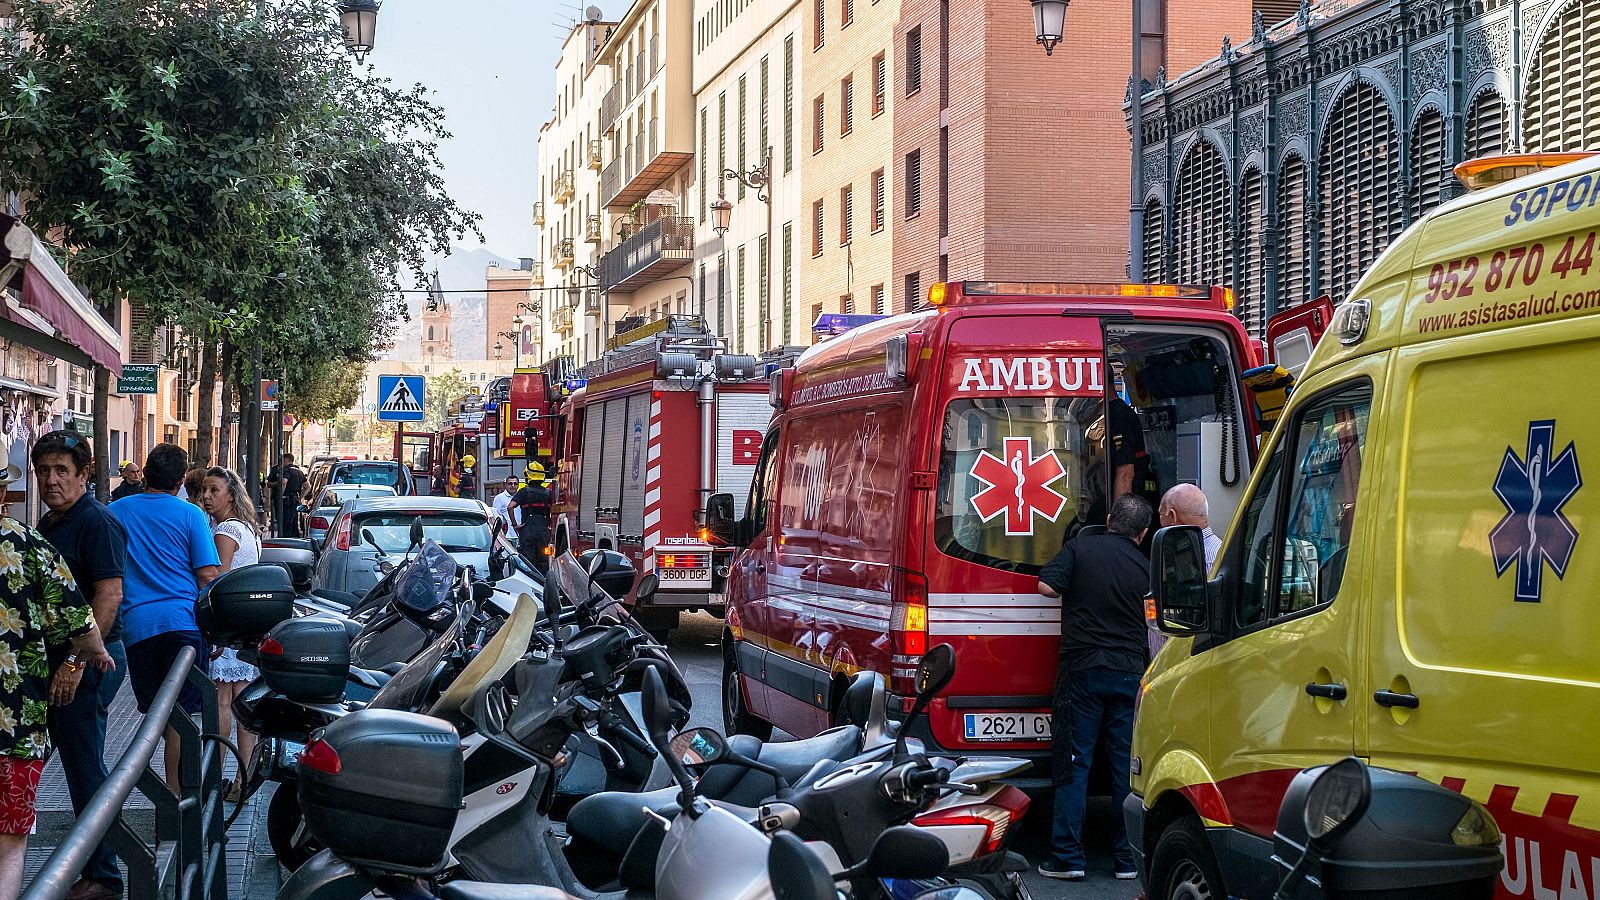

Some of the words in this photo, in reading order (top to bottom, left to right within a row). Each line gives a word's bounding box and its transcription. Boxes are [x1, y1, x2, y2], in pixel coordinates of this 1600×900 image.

[1424, 256, 1480, 304] 952
[1484, 243, 1545, 293] 870
[1550, 231, 1600, 280] 44
[1418, 290, 1600, 334] www.asistasalud.com
[957, 357, 1104, 392] AMBUL
[517, 410, 538, 419] E-2
[663, 569, 686, 580] 3600
[689, 569, 707, 580] DGP
[981, 716, 1025, 735] 2621
